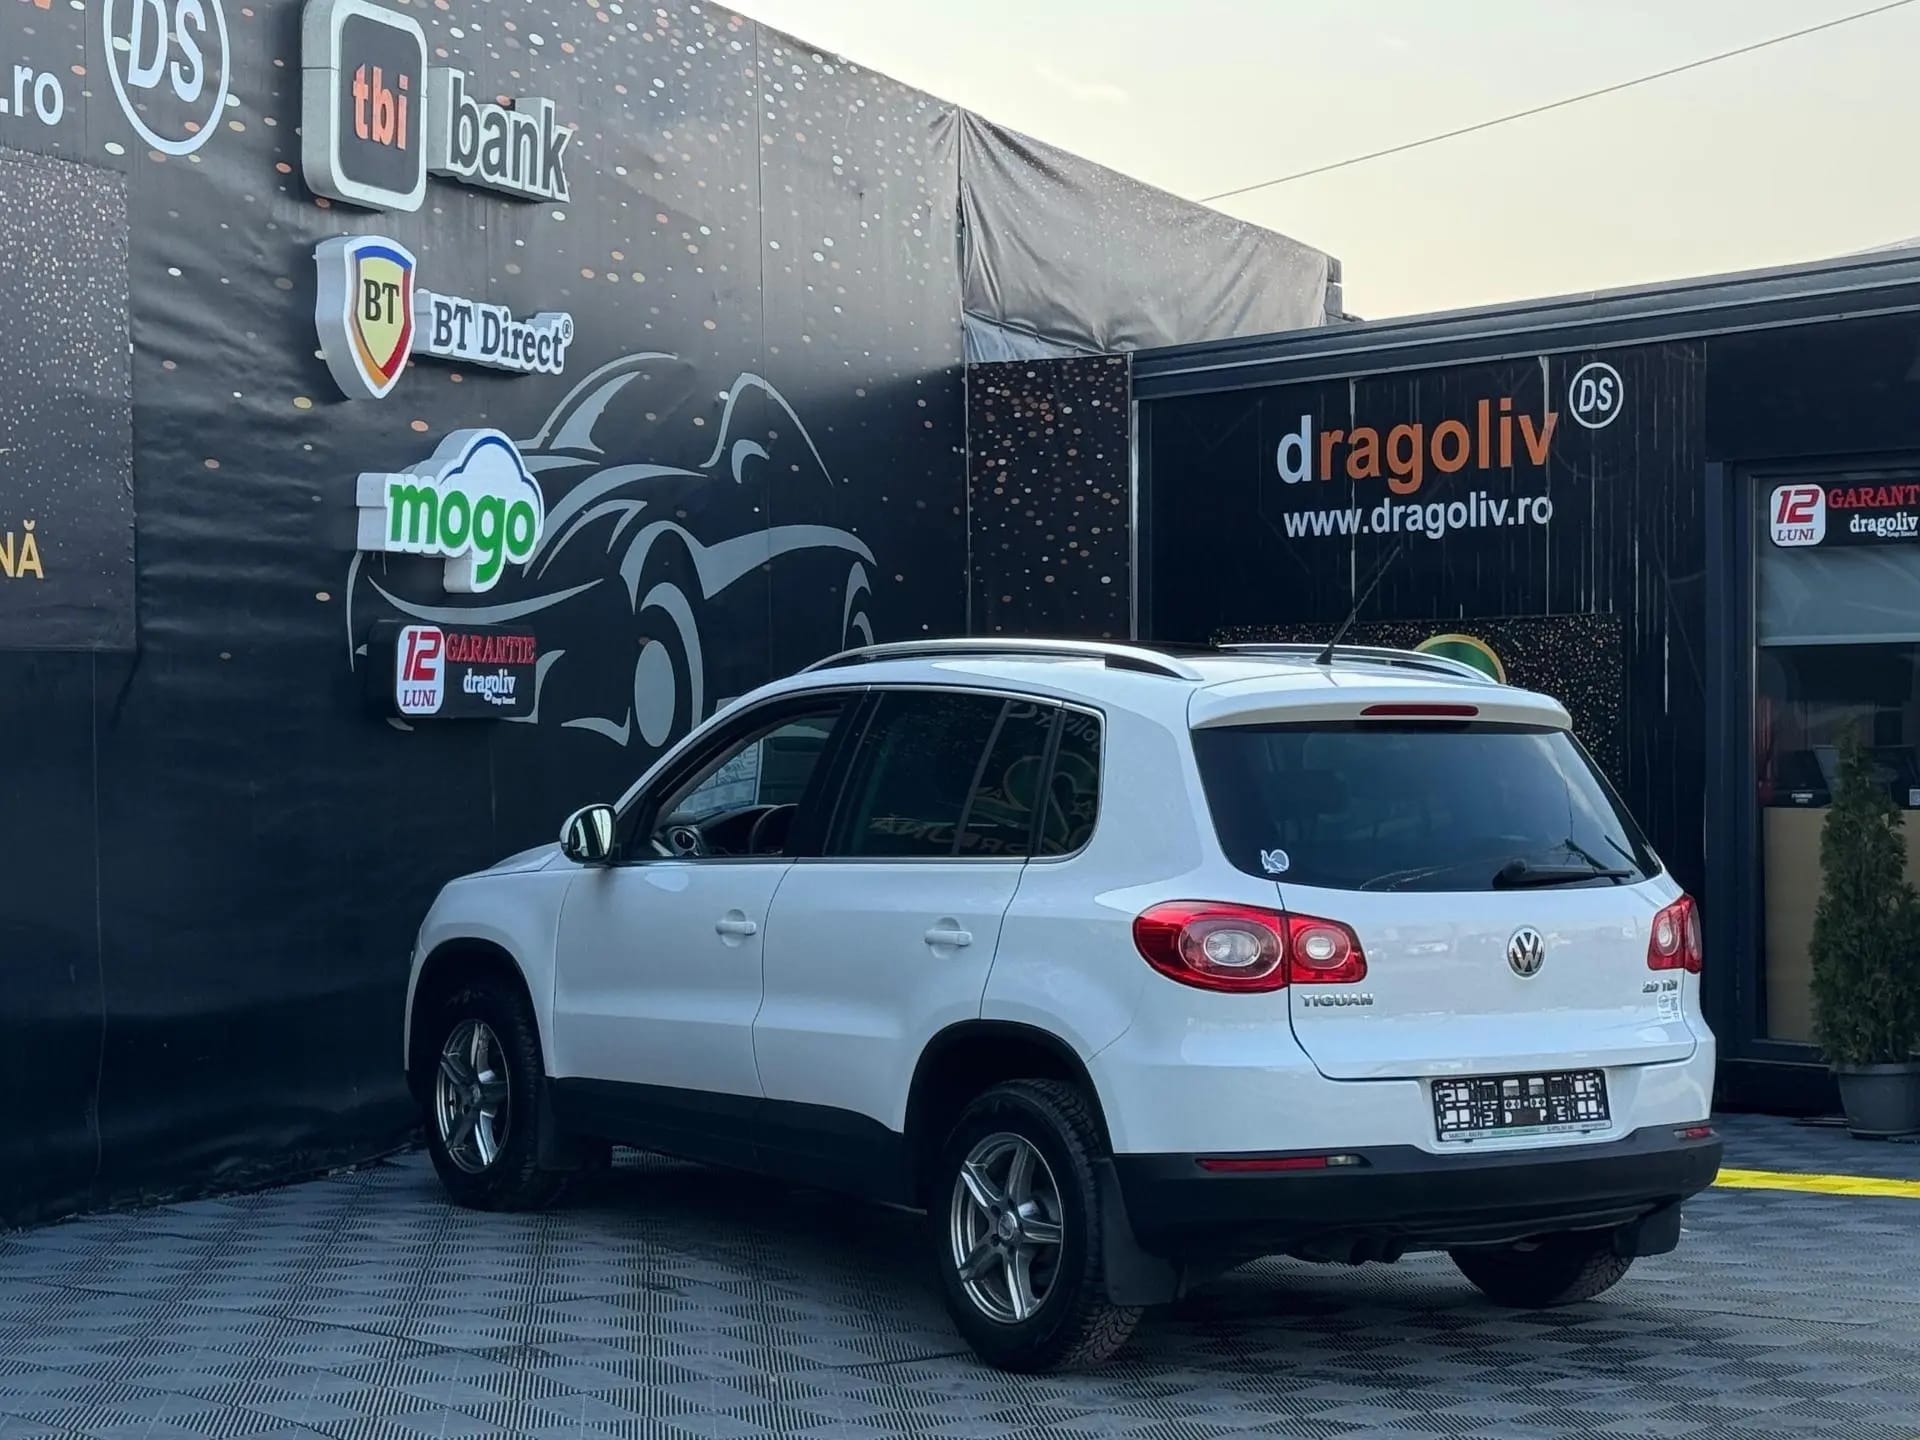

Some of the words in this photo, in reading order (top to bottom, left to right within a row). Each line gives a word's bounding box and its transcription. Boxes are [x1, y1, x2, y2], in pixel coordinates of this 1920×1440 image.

[128, 0, 206, 103] DS
[352, 63, 408, 151] tbi
[450, 75, 566, 196] bank
[363, 278, 400, 325] BT
[433, 301, 473, 350] BT
[1579, 378, 1613, 412] DS
[1276, 397, 1558, 494] dragoliv
[1283, 491, 1553, 540] www.dragoliv.ro
[1776, 488, 1820, 524] 12
[1849, 511, 1919, 537] dragoliv
[389, 484, 536, 584] mogo
[1776, 528, 1815, 542] LUNI
[403, 631, 442, 681] 12
[445, 633, 537, 665] GARANTIE
[402, 689, 437, 707] LUNI
[463, 667, 516, 701] dragoliv
[1300, 992, 1374, 1007] TIGUAN
